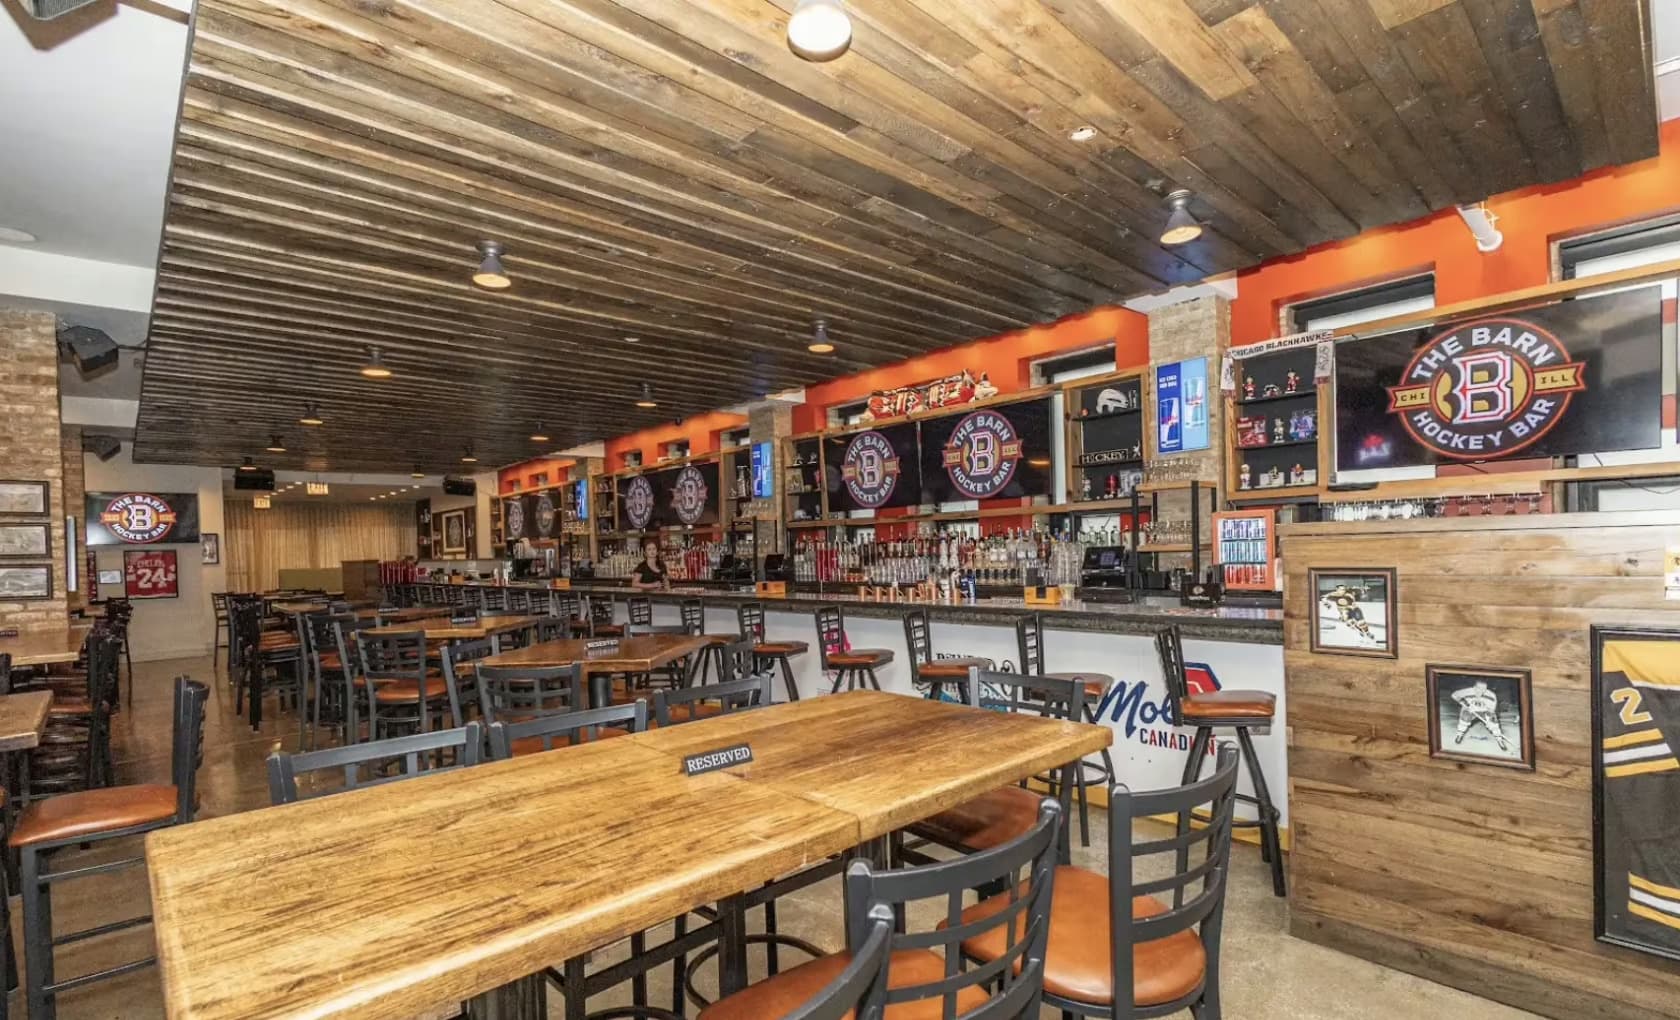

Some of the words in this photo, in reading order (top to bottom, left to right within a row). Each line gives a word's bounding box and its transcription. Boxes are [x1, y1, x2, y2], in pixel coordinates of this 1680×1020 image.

[1412, 336, 1464, 379] THE
[1471, 327, 1556, 366] BARN
[1452, 351, 1513, 424] B
[1540, 373, 1569, 384] ILL
[1400, 392, 1425, 402] CHI
[953, 420, 974, 447] THE
[976, 416, 1011, 441] BARN
[1412, 411, 1503, 450] HOCKEY
[1509, 398, 1556, 438] BAR
[848, 439, 864, 463] THE
[865, 436, 890, 458] BARN
[880, 476, 892, 497] BAR
[953, 467, 991, 492] HOCKEY
[993, 462, 1012, 486] BAR
[111, 496, 133, 512] THE
[134, 495, 167, 513] BARN
[112, 523, 151, 540] HOCKEY
[151, 523, 168, 537] BAR
[137, 568, 168, 589] 24
[1610, 687, 1653, 725] 2
[1140, 728, 1217, 756] CANADIN
[687, 747, 750, 772] RESERVED
